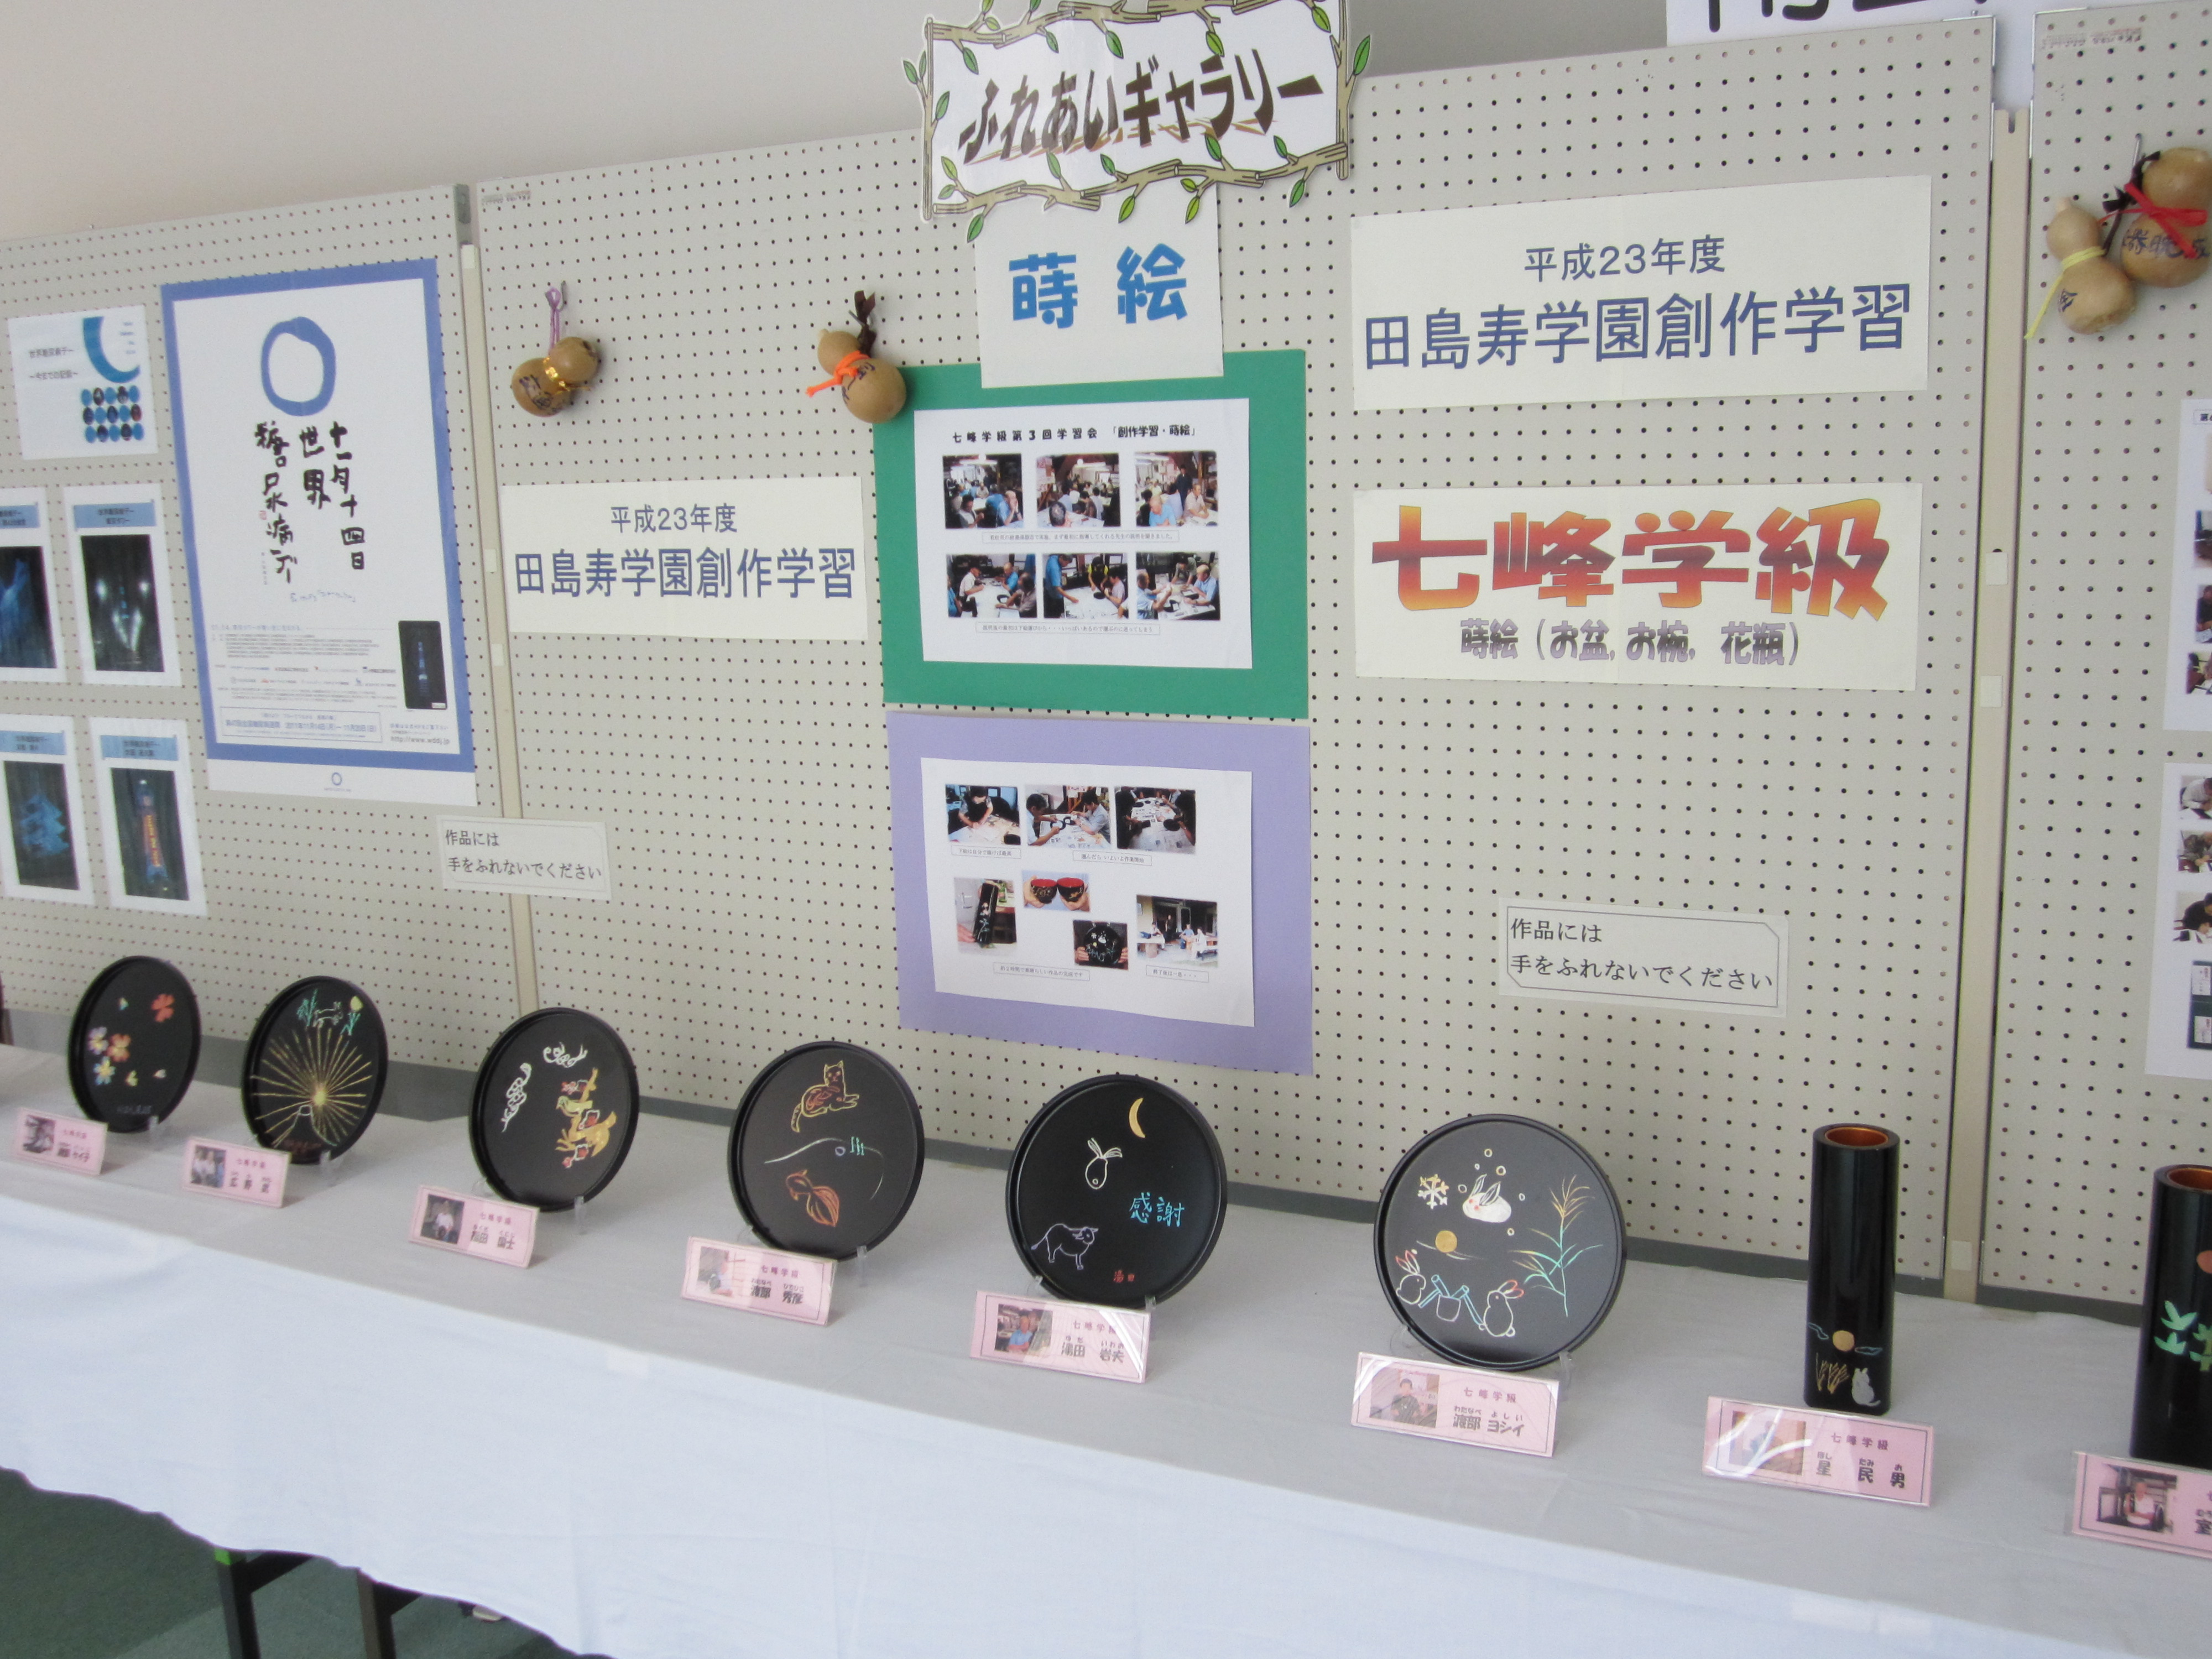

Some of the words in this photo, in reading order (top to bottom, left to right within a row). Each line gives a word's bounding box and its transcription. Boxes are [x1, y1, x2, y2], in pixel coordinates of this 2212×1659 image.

[958, 49, 1324, 164] ふれあいギャラリー
[1524, 234, 1726, 283] 平成23年度
[1009, 243, 1188, 329] 蒔絵
[1365, 283, 1911, 370] 田島寿学園創作学習
[299, 425, 332, 510] 世界
[611, 503, 737, 533] 平成23年度
[515, 546, 855, 598] 田島寿学園創作学習
[1372, 498, 1890, 621] 七峰学級
[445, 829, 500, 847] 作品には
[447, 857, 602, 881] 手をふれないでください
[1510, 917, 1603, 943] 作品には
[1510, 954, 1773, 990] 手をふれないでください
[1129, 1192, 1185, 1227] 感謝
[1487, 1419, 1525, 1437] ヨシイ
